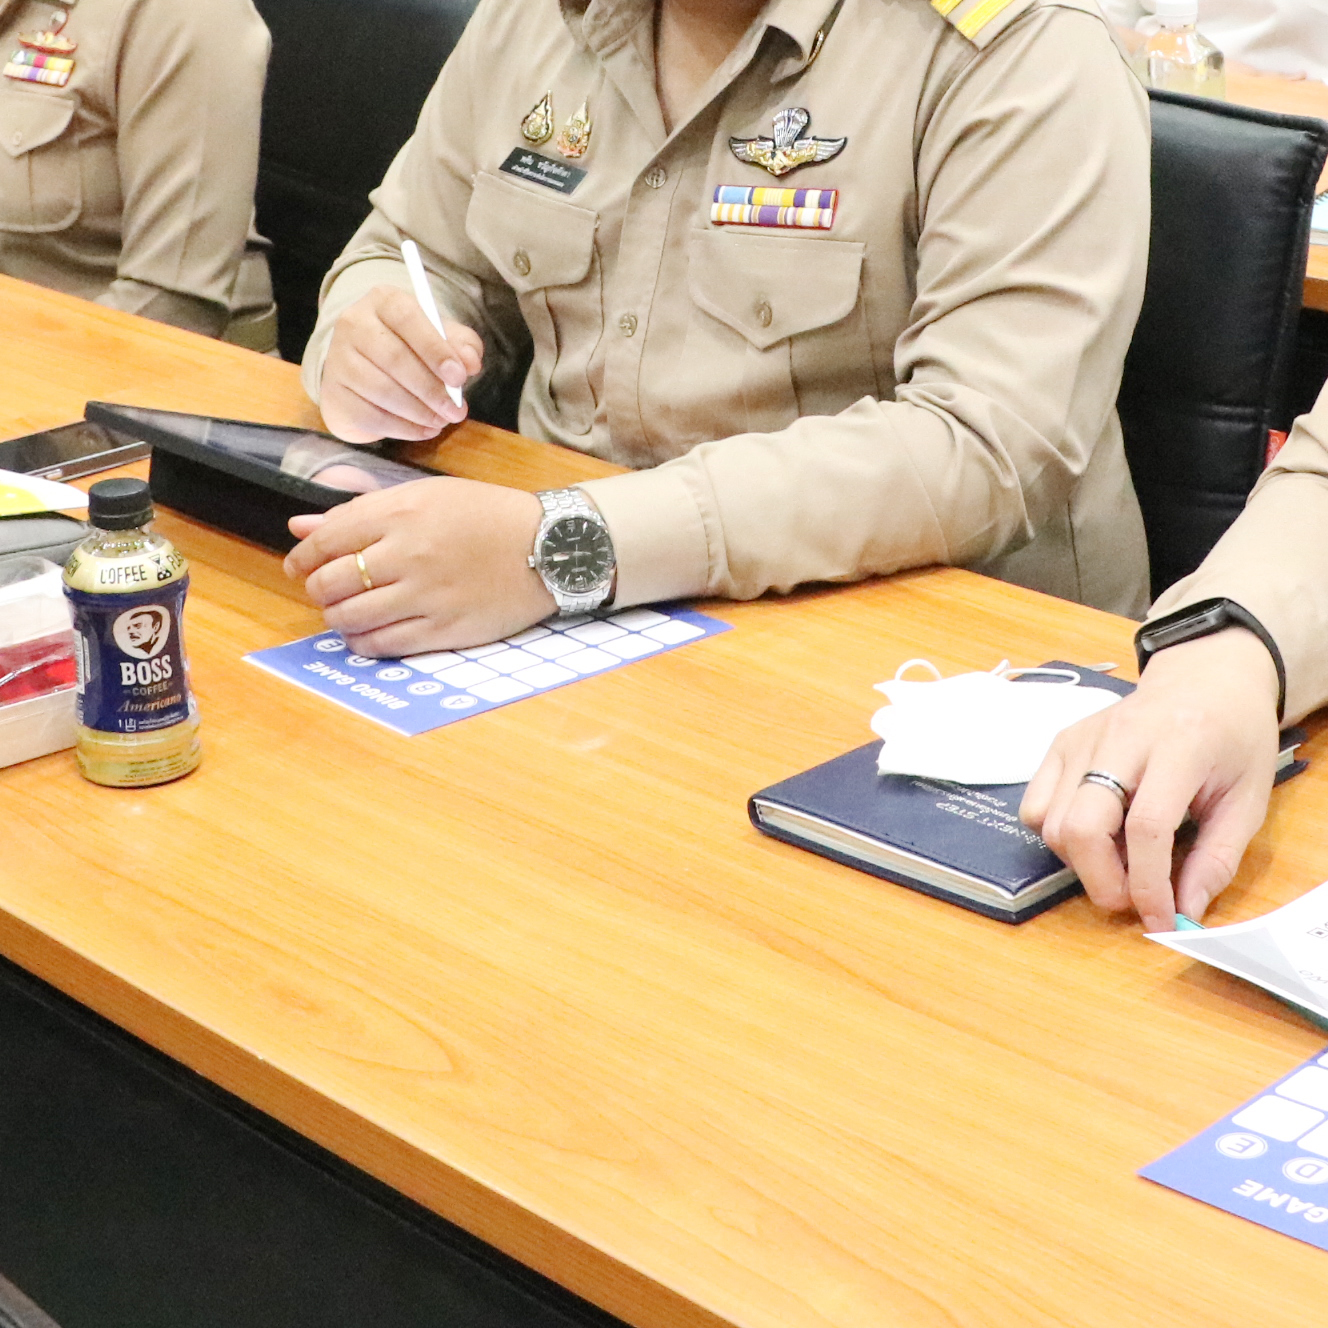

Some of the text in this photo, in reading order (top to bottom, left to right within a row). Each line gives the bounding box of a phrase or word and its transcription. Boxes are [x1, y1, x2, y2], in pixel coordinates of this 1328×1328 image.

[119, 654, 172, 685] BOSS
[132, 681, 168, 696] COFFEE
[302, 661, 410, 710] BINGO GAME
[115, 693, 182, 712] Americano
[935, 802, 980, 820] STEP
[1226, 1135, 1257, 1155] E
[1294, 1161, 1325, 1179] D
